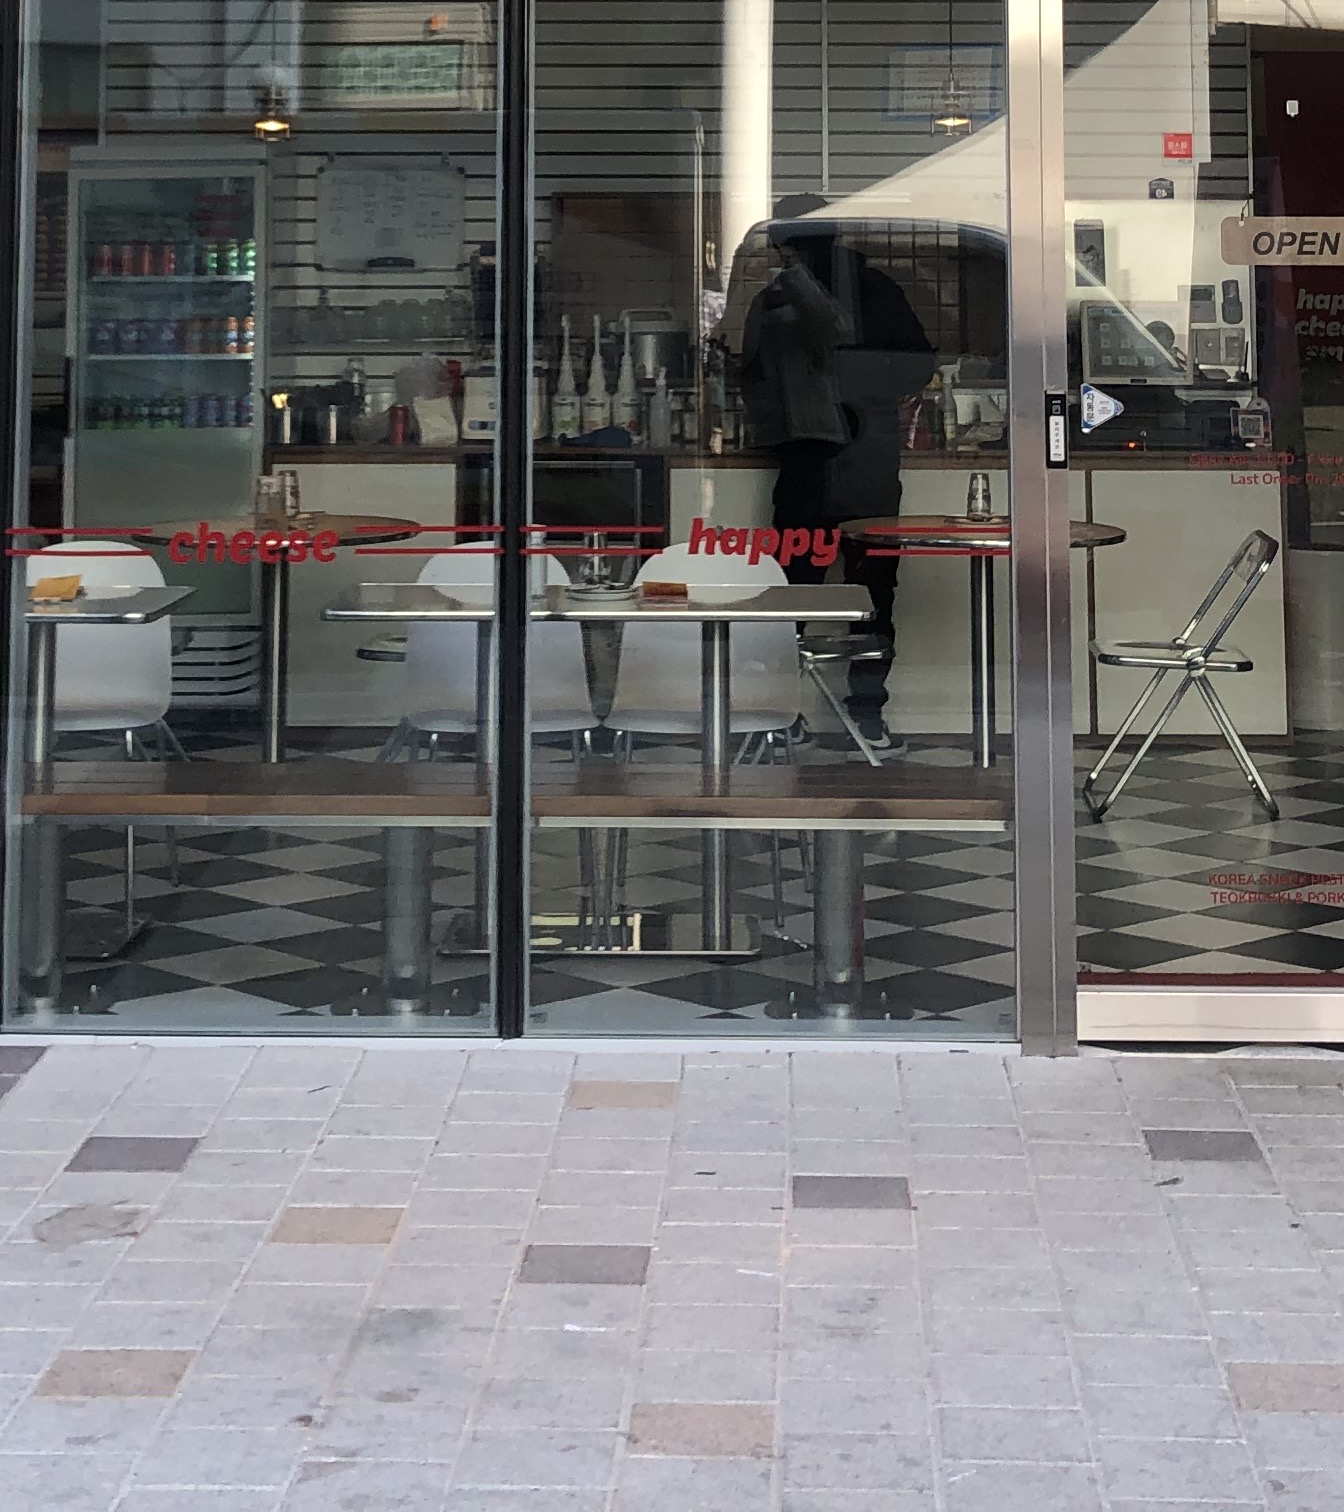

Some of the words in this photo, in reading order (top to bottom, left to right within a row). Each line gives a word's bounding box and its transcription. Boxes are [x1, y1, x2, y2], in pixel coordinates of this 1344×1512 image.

[1252, 230, 1342, 257] OPEN
[168, 521, 340, 566] cheese
[688, 516, 842, 566] happy
[1207, 873, 1256, 885] KOREA
